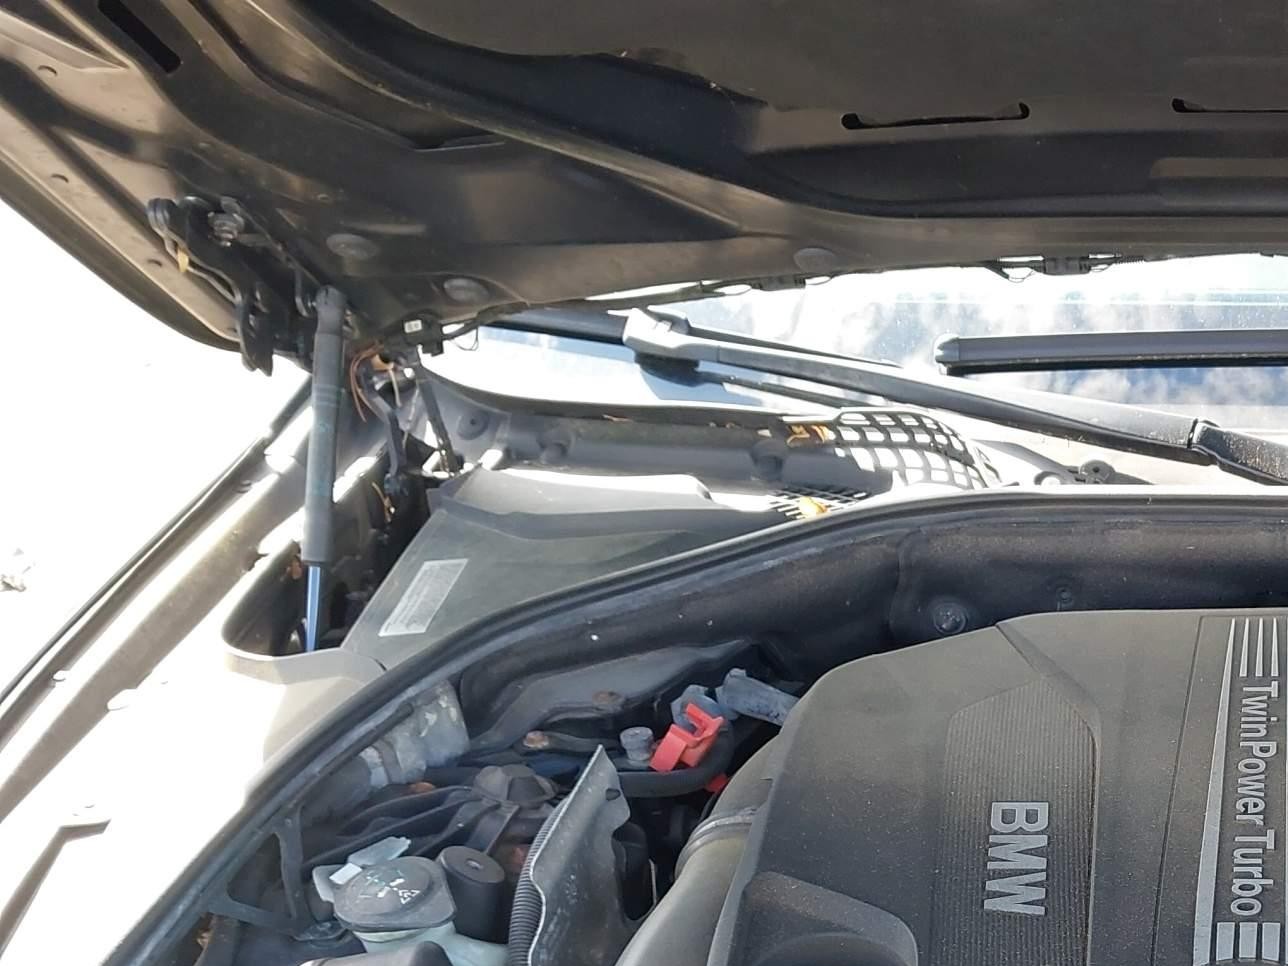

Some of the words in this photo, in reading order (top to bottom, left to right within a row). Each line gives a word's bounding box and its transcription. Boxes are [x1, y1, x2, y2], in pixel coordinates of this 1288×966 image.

[1234, 681, 1279, 825] TwinPower
[984, 801, 1049, 916] BMW
[1231, 830, 1275, 917] Turbo
